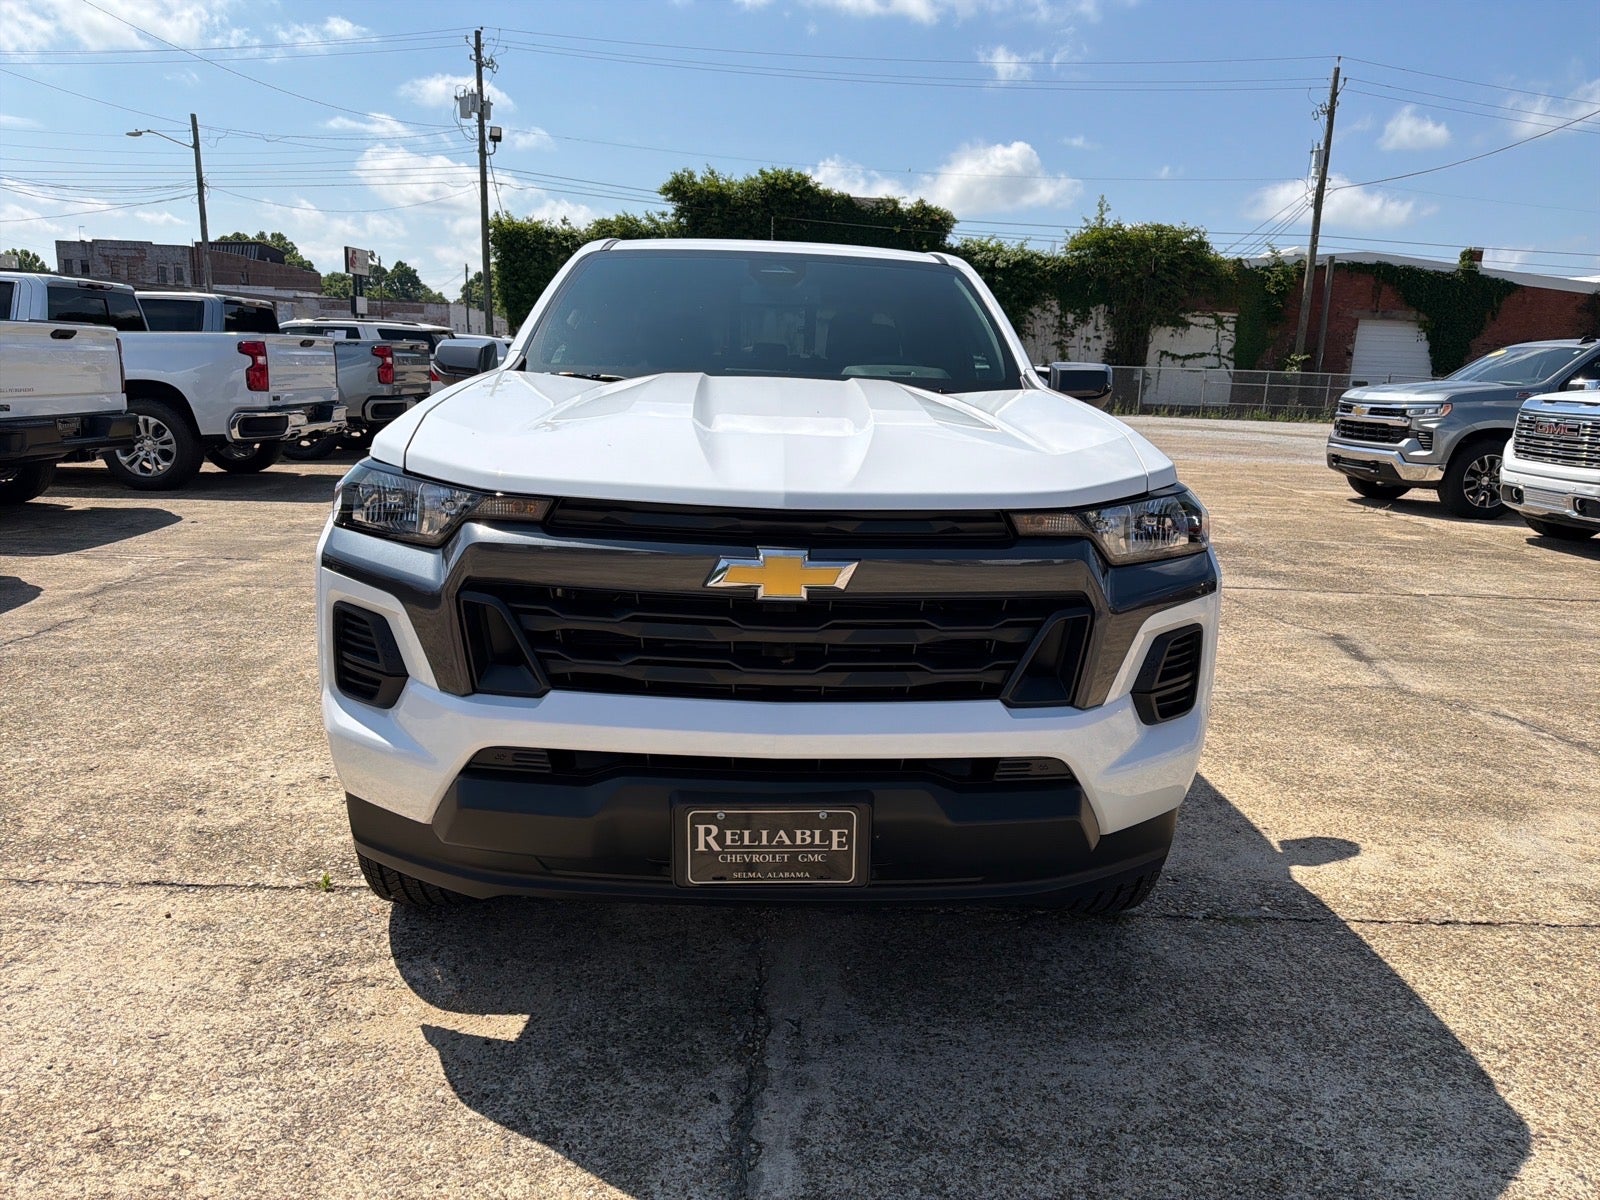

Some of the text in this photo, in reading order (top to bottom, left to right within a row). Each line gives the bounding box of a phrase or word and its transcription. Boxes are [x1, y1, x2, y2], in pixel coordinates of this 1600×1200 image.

[1536, 422, 1579, 437] GMC
[695, 824, 848, 852] RELIABLE
[718, 853, 827, 863] CHEVROLET GMC
[733, 871, 810, 879] SELMA, ALABAMA
